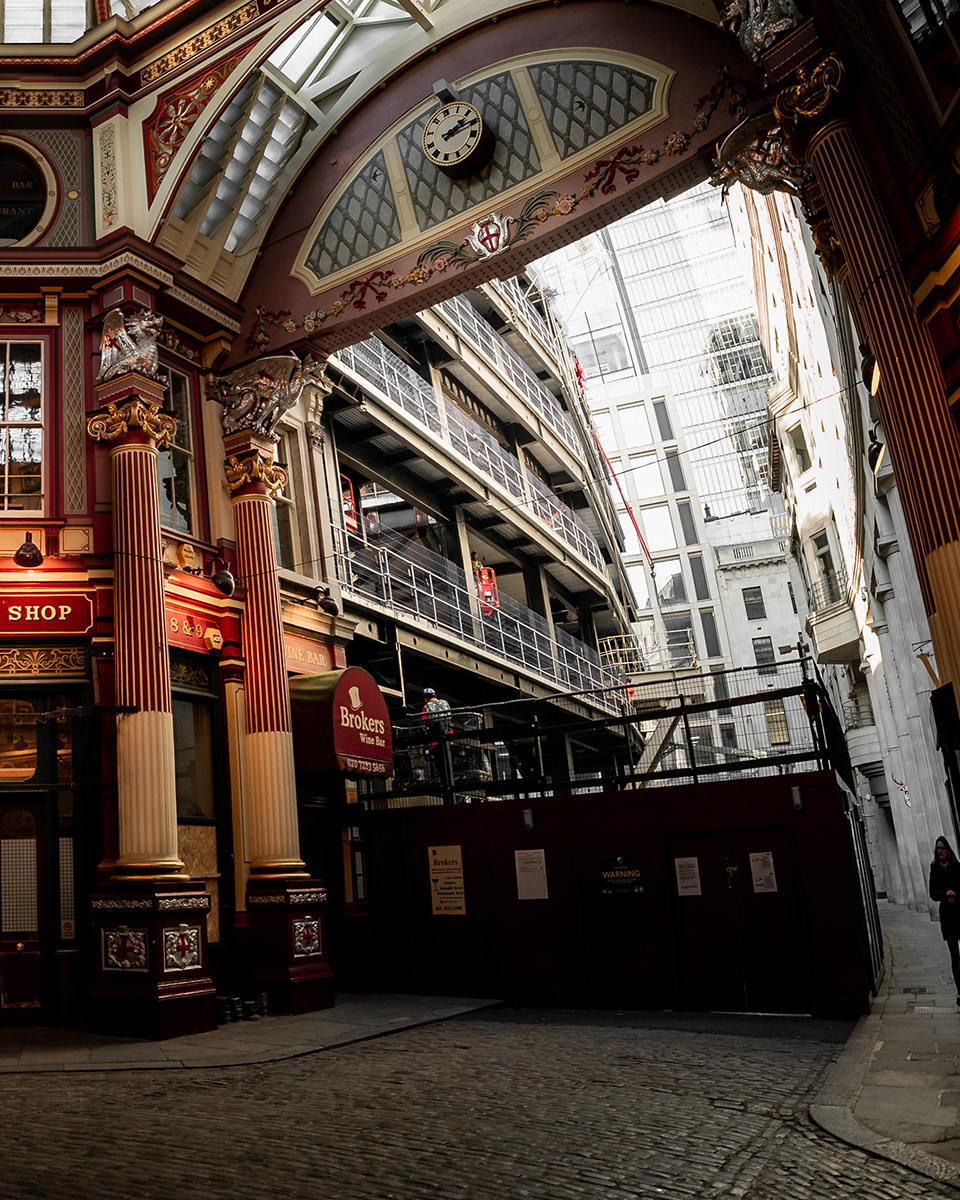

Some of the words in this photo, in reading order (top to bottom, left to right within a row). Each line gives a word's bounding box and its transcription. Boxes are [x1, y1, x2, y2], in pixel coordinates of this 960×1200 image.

[11, 181, 33, 189] BAR
[12, 373, 39, 381] WINE
[15, 381, 35, 389] BAR
[8, 605, 72, 621] SHOP
[170, 617, 179, 633] 8
[182, 620, 193, 637] &
[196, 624, 204, 638] 9
[306, 650, 327, 667] BAR
[340, 705, 385, 734] Brokers
[359, 732, 375, 745] Wine
[375, 736, 386, 747] Bar
[347, 758, 358, 768] 020
[433, 858, 459, 866] Brokers
[602, 869, 640, 879] WARNING
